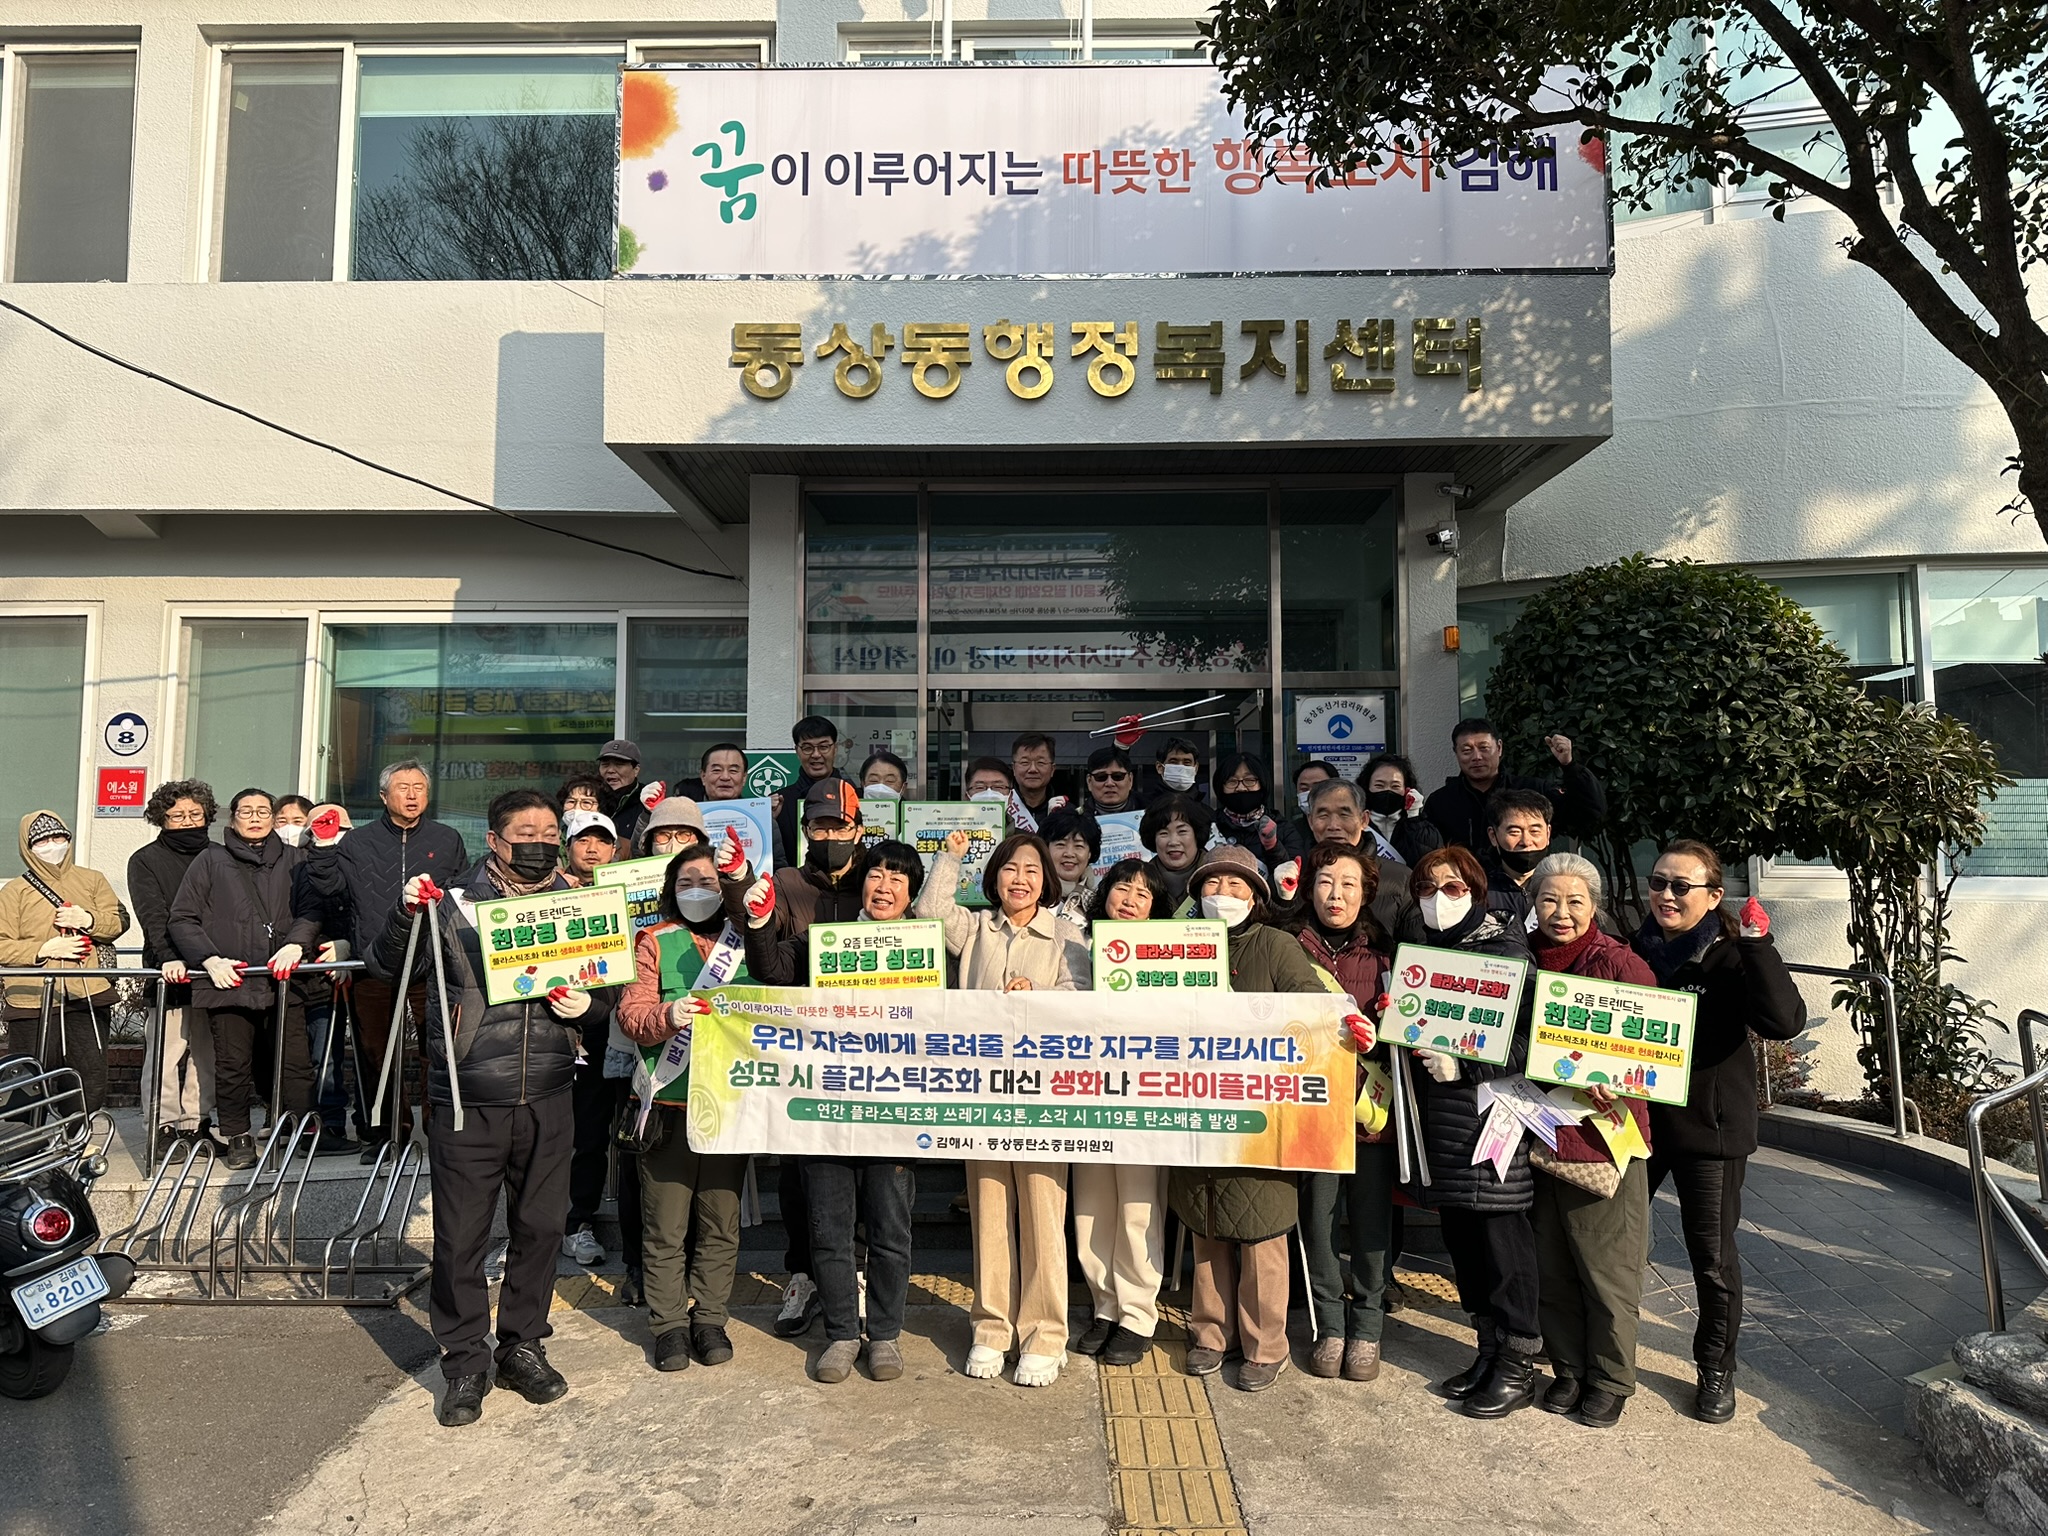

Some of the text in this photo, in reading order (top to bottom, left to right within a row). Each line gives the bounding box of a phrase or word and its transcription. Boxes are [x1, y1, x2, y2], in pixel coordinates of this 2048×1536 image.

[692, 120, 809, 224] 꿈이
[824, 150, 1043, 196] 이루어지는
[1063, 148, 1196, 195] 따뜻한
[731, 318, 1482, 400] 동상동행정복지센터
[1303, 700, 1377, 724] 동상동선거관리위원회
[107, 782, 138, 793] 에스원
[917, 841, 938, 852] 조화
[492, 912, 506, 920] YES
[516, 905, 582, 923] 요즘 트렌드는
[491, 922, 557, 952] 친환경
[566, 913, 619, 940] 성묘!
[843, 936, 902, 949] 요즘 트렌드는
[492, 939, 624, 965] 플라스틱조화 대신 생화로 헌화합시다
[819, 948, 934, 974] 친환경 성묘!
[1135, 943, 1217, 959] 플라스틱 조화!
[817, 977, 860, 988] 플라스틱조화
[903, 975, 938, 984] 헌화합시다
[1136, 970, 1218, 987] 친환경 성묘!
[1430, 972, 1511, 1000] 플라스틱 조화!
[1551, 985, 1566, 994] YES
[713, 994, 913, 1019] 꿈이 이루어지는 따뜻한 행복도시 김해
[1424, 998, 1505, 1028] 친환경 성묘!
[1574, 992, 1644, 1015] 요즘 트렌드는
[1544, 1001, 1680, 1046] 친환경 성묘!
[752, 1024, 1304, 1063] 우리 자손에게 물려줄 소중한 지구를 지킵시다.
[1539, 1030, 1680, 1062] 플라스틱조화 대신 생화로 헌화합시다
[729, 1061, 1328, 1103] 성묘 시 플라스틱조화 대신 생화나 드라이플라워로
[817, 1104, 845, 1120] 연간
[850, 1105, 938, 1122] 플라스틱조화
[943, 1108, 987, 1124] 쓰레기
[992, 1109, 1032, 1125] 43톤,
[1039, 1109, 1068, 1125] 소각
[1074, 1110, 1087, 1125] 시
[1094, 1111, 1138, 1127] 119톤
[1144, 1111, 1203, 1129] 탄소배출
[1208, 1113, 1238, 1130] 발생
[937, 1137, 974, 1150] 김해시
[987, 1138, 1114, 1153] 동상동탄소중립위원회
[36, 1267, 78, 1293] 경남 김해
[45, 1274, 96, 1309] 8201
